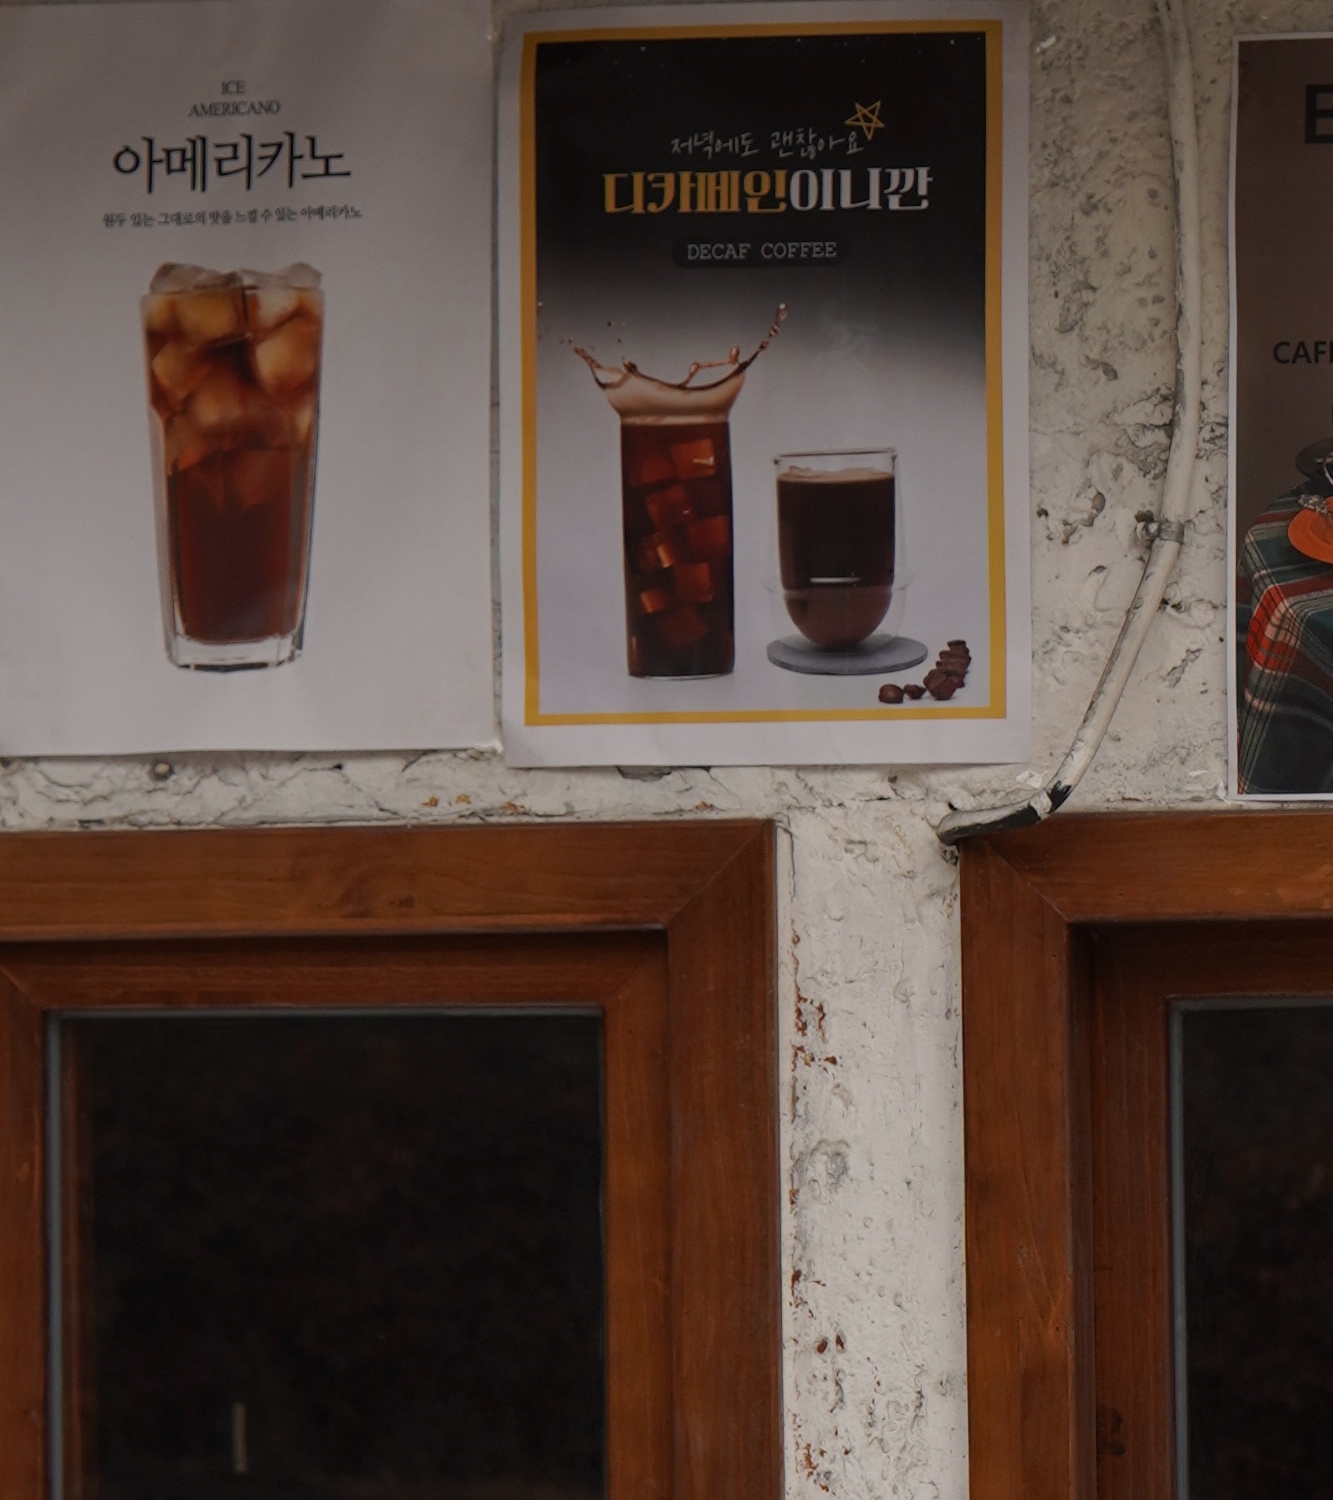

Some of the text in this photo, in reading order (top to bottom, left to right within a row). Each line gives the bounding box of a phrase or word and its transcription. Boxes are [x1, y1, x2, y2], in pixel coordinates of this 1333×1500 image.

[221, 80, 246, 95] ICE
[188, 99, 281, 117] AMERICANO
[670, 127, 864, 160] 저녁에도 괜찮아요
[112, 130, 352, 194] 아메리카노
[687, 241, 837, 261] DECAF COFFEE
